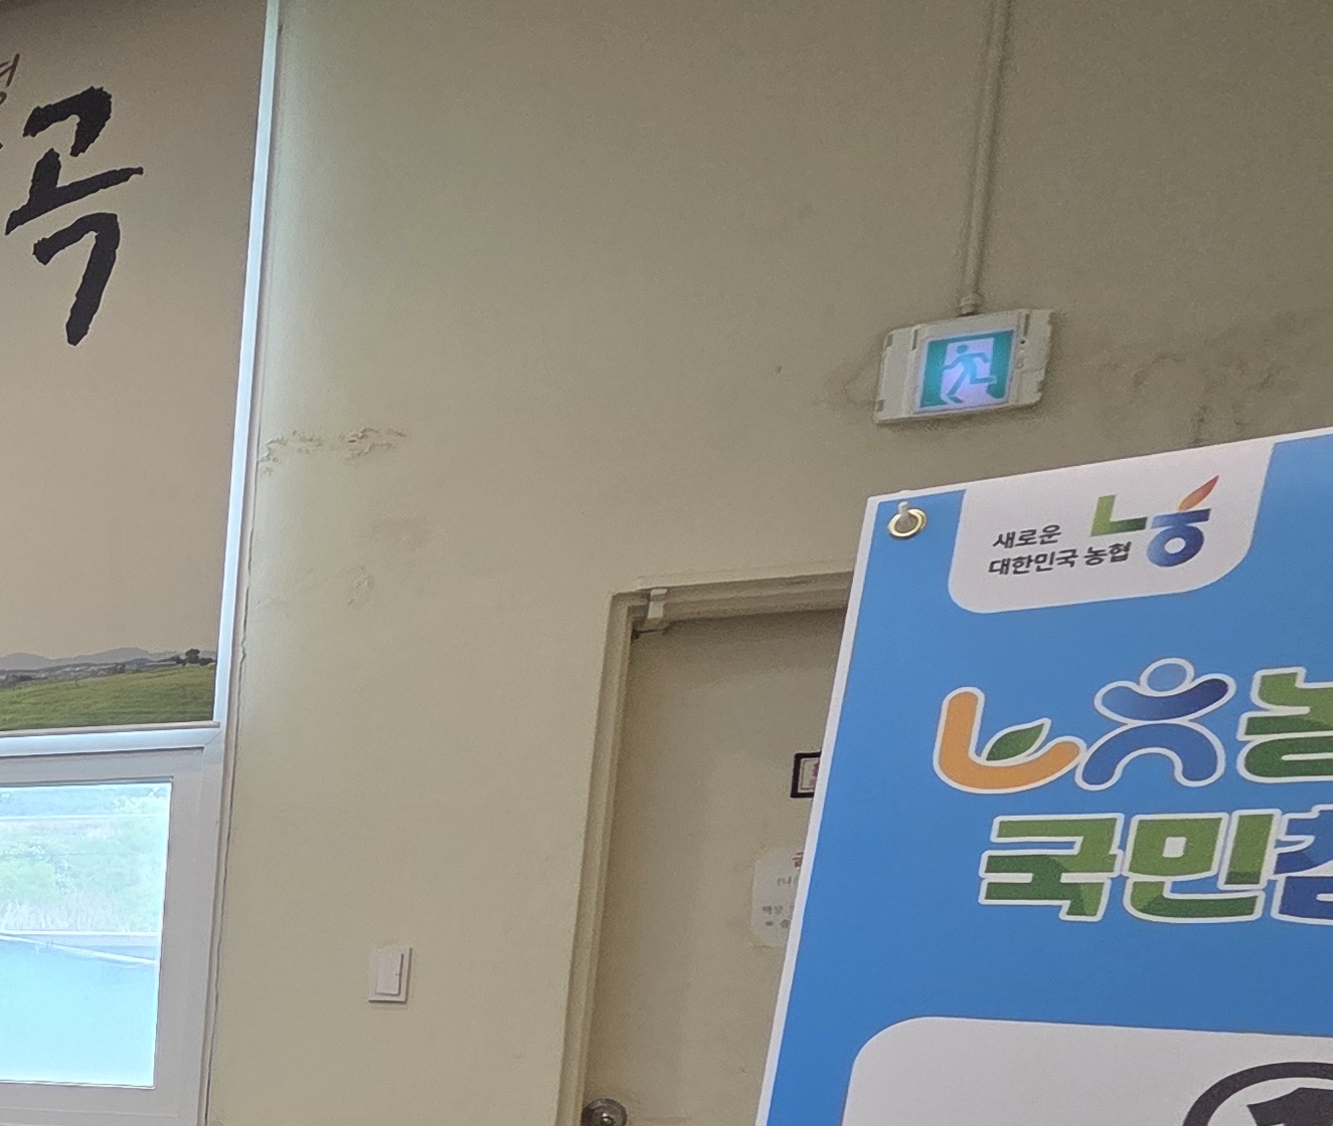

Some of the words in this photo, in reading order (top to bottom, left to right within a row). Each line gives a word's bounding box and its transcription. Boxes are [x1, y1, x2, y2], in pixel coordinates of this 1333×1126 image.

[992, 524, 1062, 549] 새로운
[989, 549, 1079, 576] 대한민국
[1083, 541, 1132, 566] 농협
